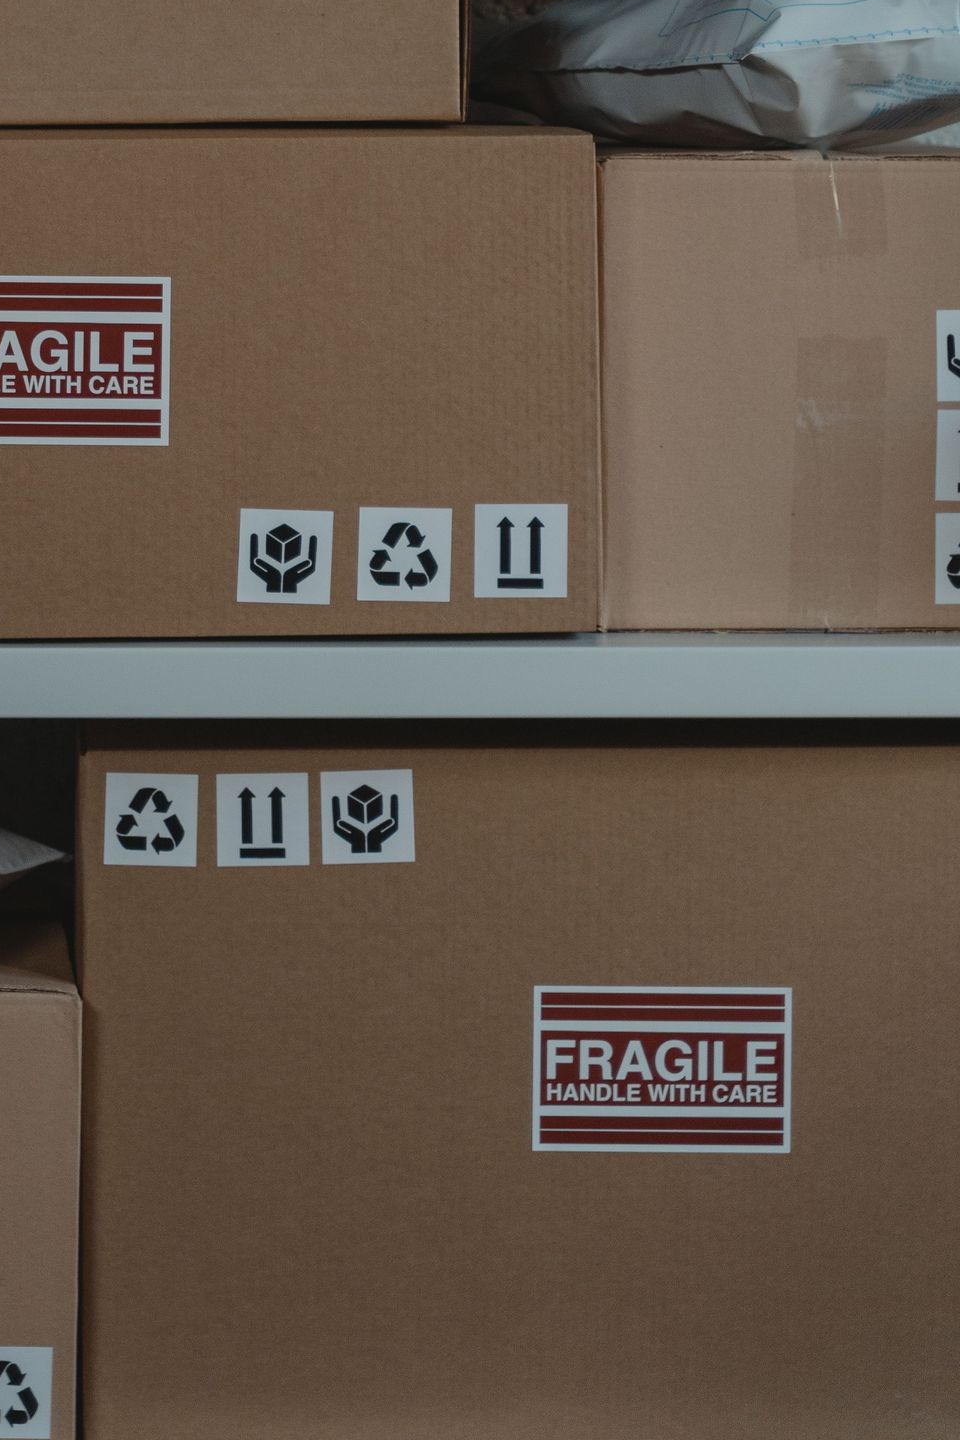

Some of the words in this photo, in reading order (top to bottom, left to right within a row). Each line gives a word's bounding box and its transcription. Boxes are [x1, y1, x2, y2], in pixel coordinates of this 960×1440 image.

[23, 375, 82, 394] WITH
[88, 375, 155, 395] CARE
[546, 1039, 778, 1082] FRAGILE
[546, 1083, 642, 1102] HANDLE
[647, 1084, 706, 1103] WITH
[711, 1084, 778, 1103] CARE
